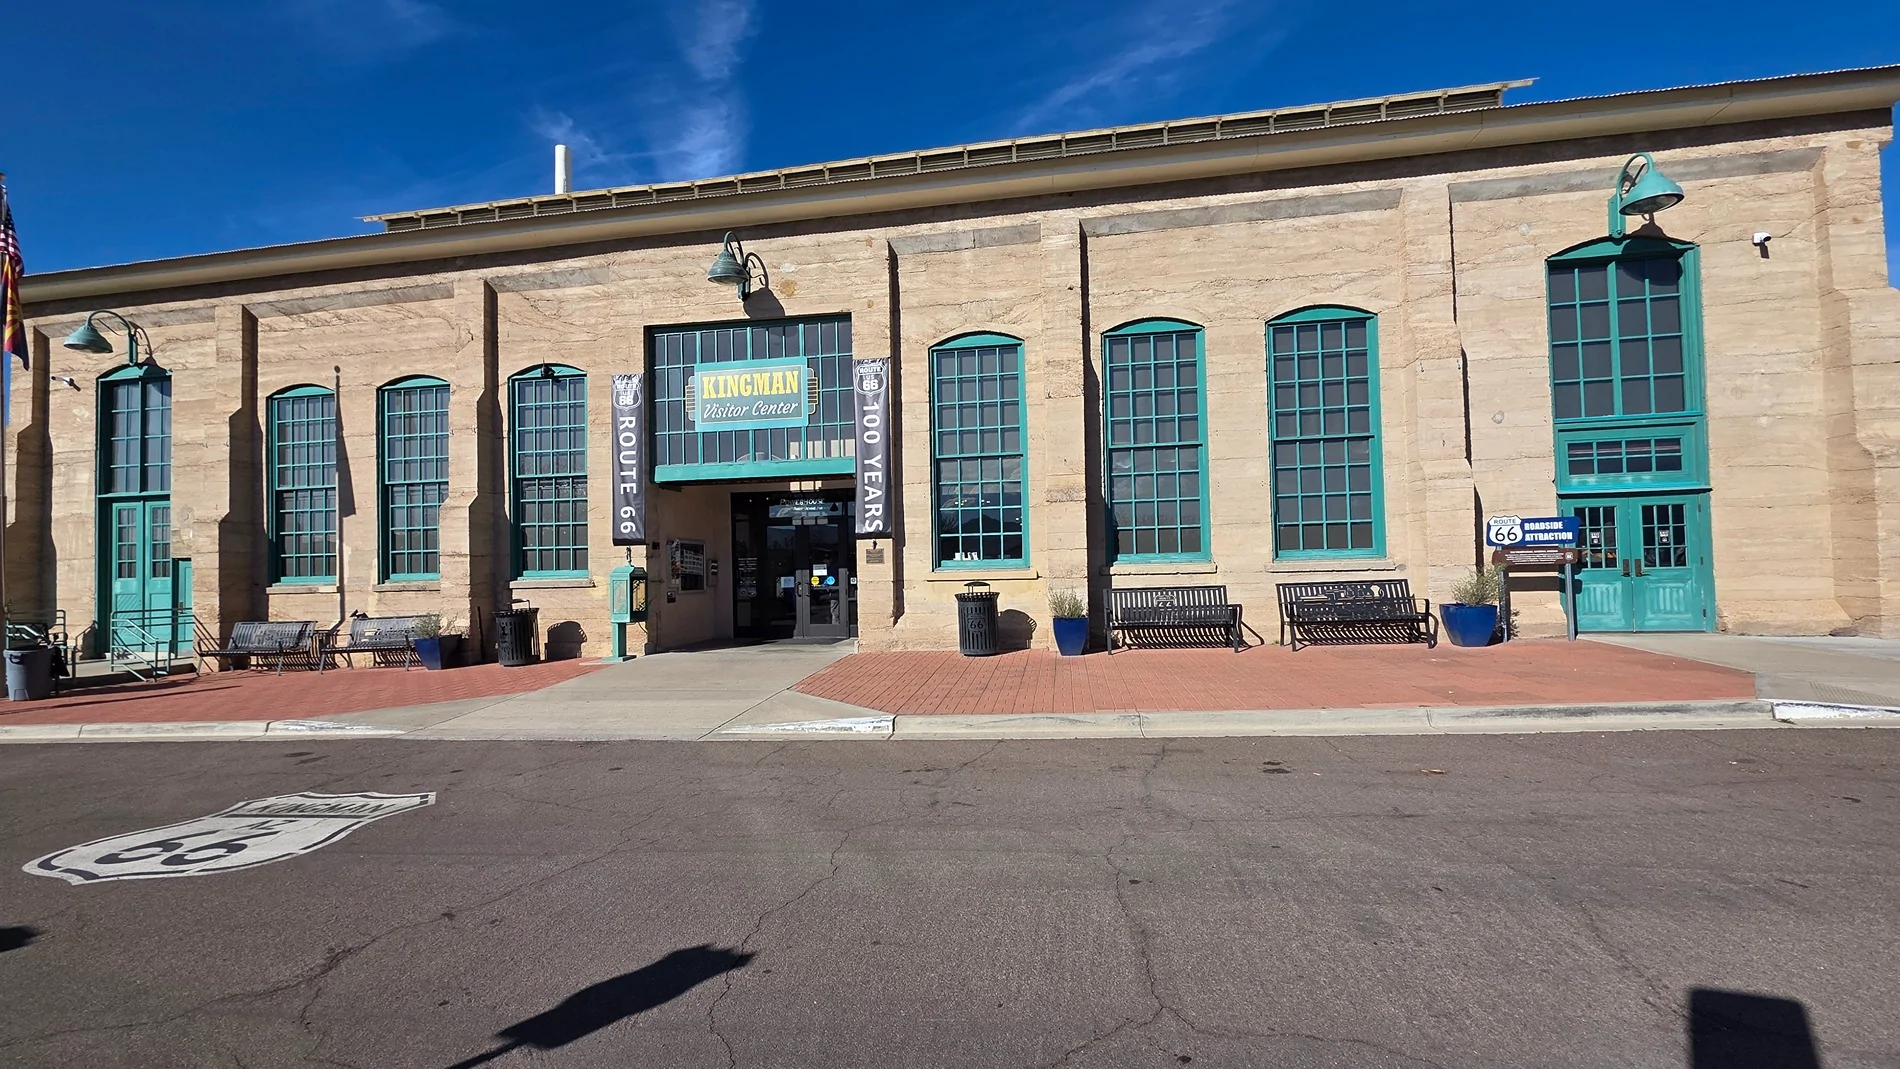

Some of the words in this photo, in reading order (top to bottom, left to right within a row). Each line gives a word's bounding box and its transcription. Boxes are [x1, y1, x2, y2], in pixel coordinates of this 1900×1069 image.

[859, 366, 882, 374] ROUTE
[702, 370, 799, 399] KINGMAN
[862, 379, 879, 391] 66
[703, 403, 750, 419] Visitor
[751, 400, 799, 416] Center
[862, 401, 881, 444] 100
[618, 416, 637, 495] ROUTE
[863, 454, 883, 533] YEARS
[619, 506, 636, 534] 66
[1524, 521, 1563, 531] ROADSIDE
[1495, 526, 1518, 542] 66
[1524, 531, 1573, 542] ATTRACTION
[970, 620, 984, 630] 66
[249, 802, 398, 814] KINGMAN
[93, 829, 281, 867] 66
